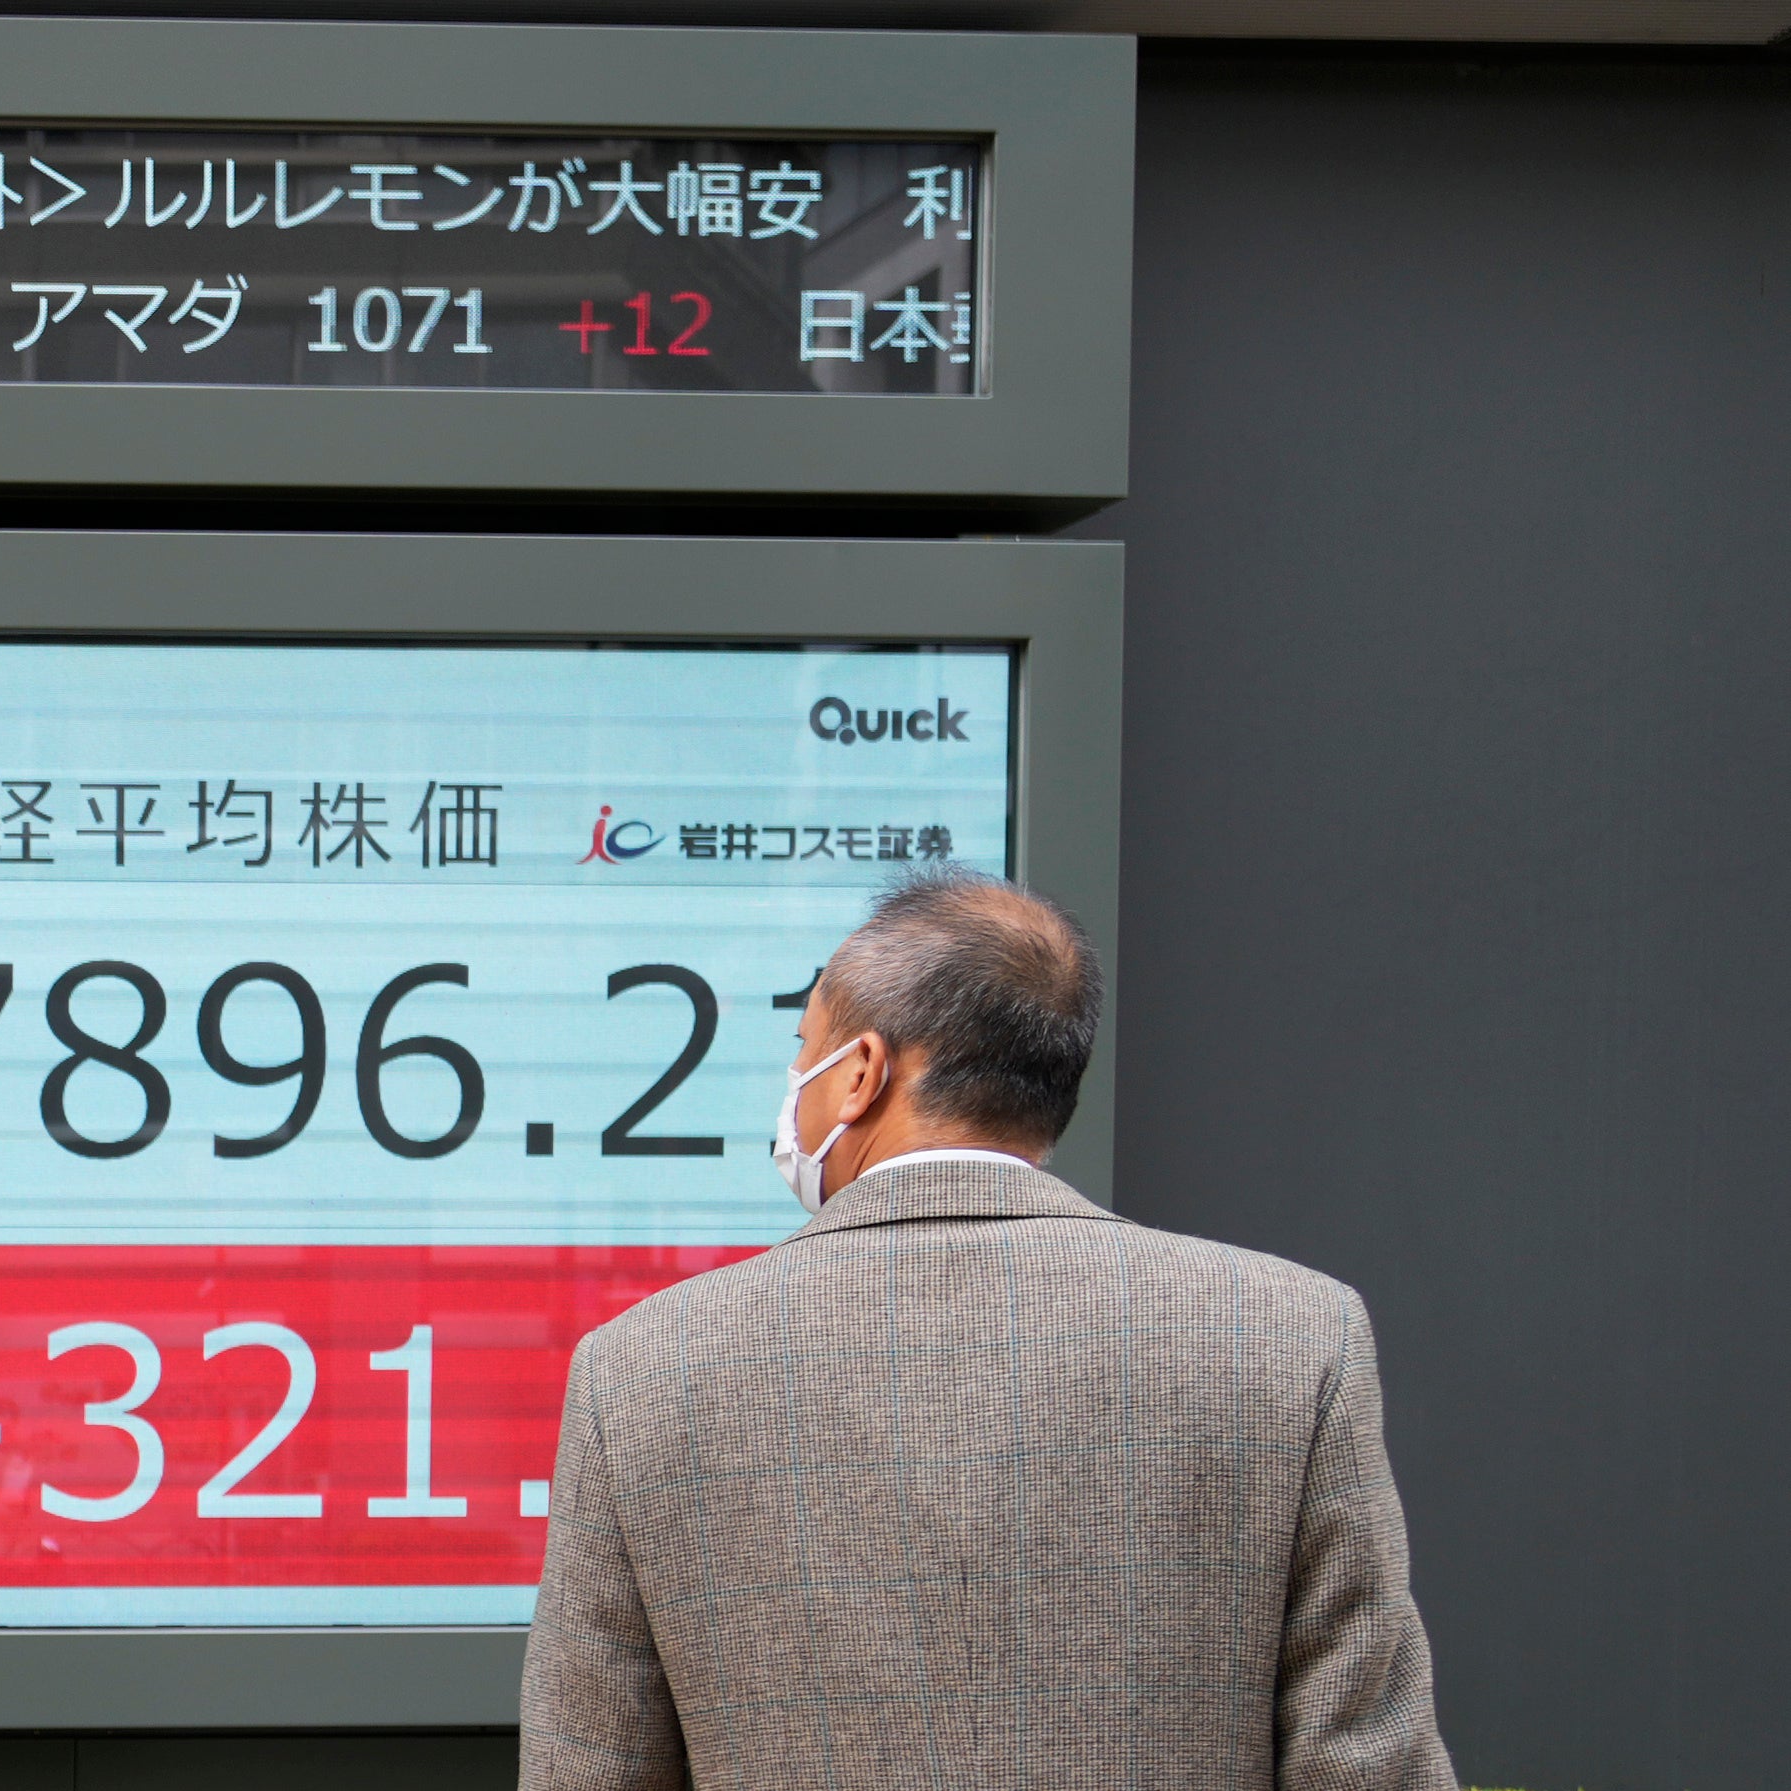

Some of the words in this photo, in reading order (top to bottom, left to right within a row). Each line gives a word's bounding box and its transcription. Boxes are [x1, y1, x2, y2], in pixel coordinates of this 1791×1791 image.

[12, 276, 247, 353] アマダ
[309, 288, 487, 353] 1071
[560, 292, 711, 356] +12
[680, 823, 952, 862] 岩井コスモ証券
